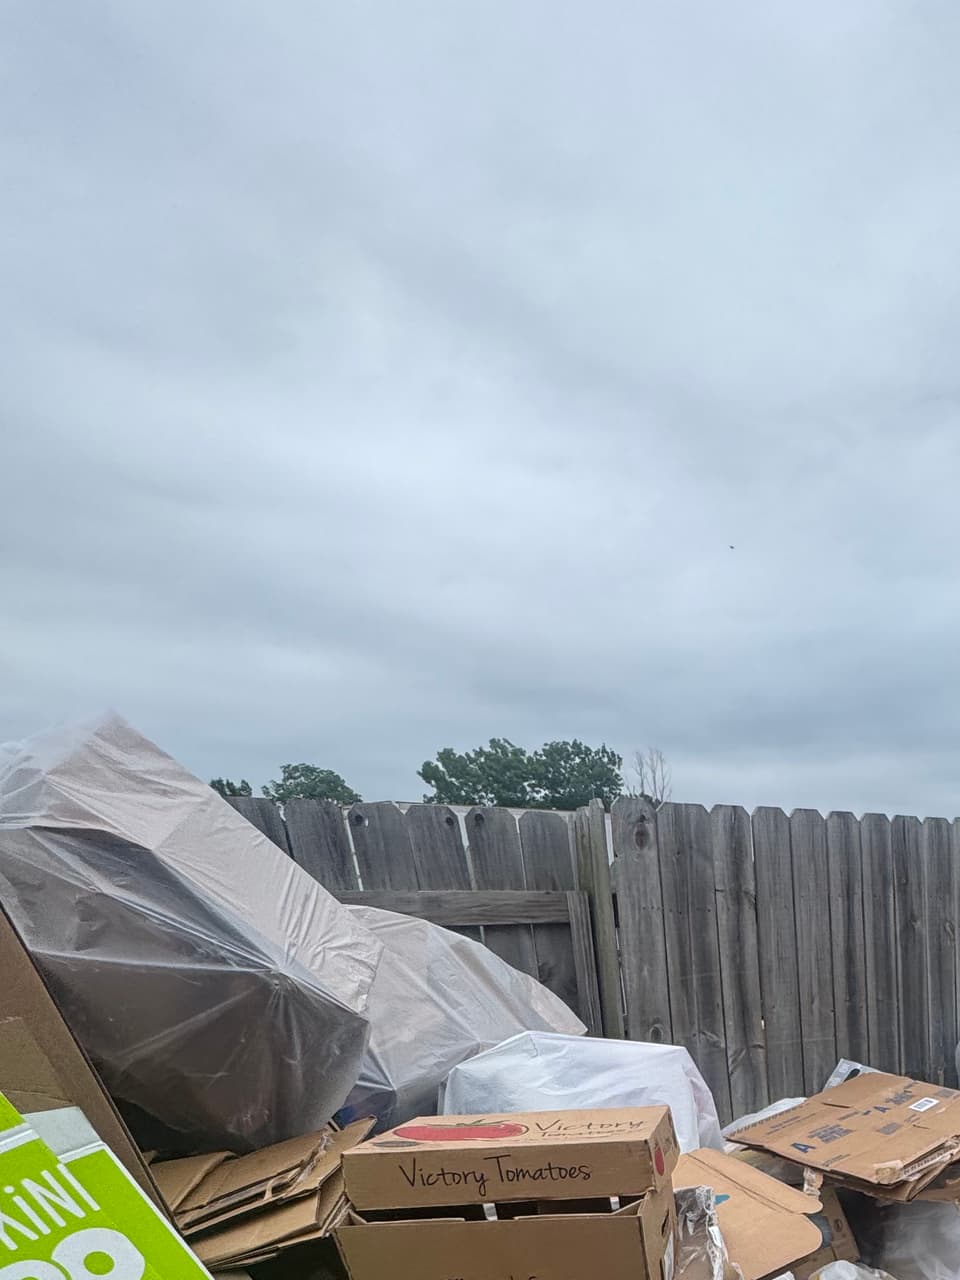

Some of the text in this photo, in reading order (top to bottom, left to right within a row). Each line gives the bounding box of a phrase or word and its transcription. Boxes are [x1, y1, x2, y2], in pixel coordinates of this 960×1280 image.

[536, 1119, 645, 1131] Victory
[399, 1154, 593, 1196] Victory Tomatoes
